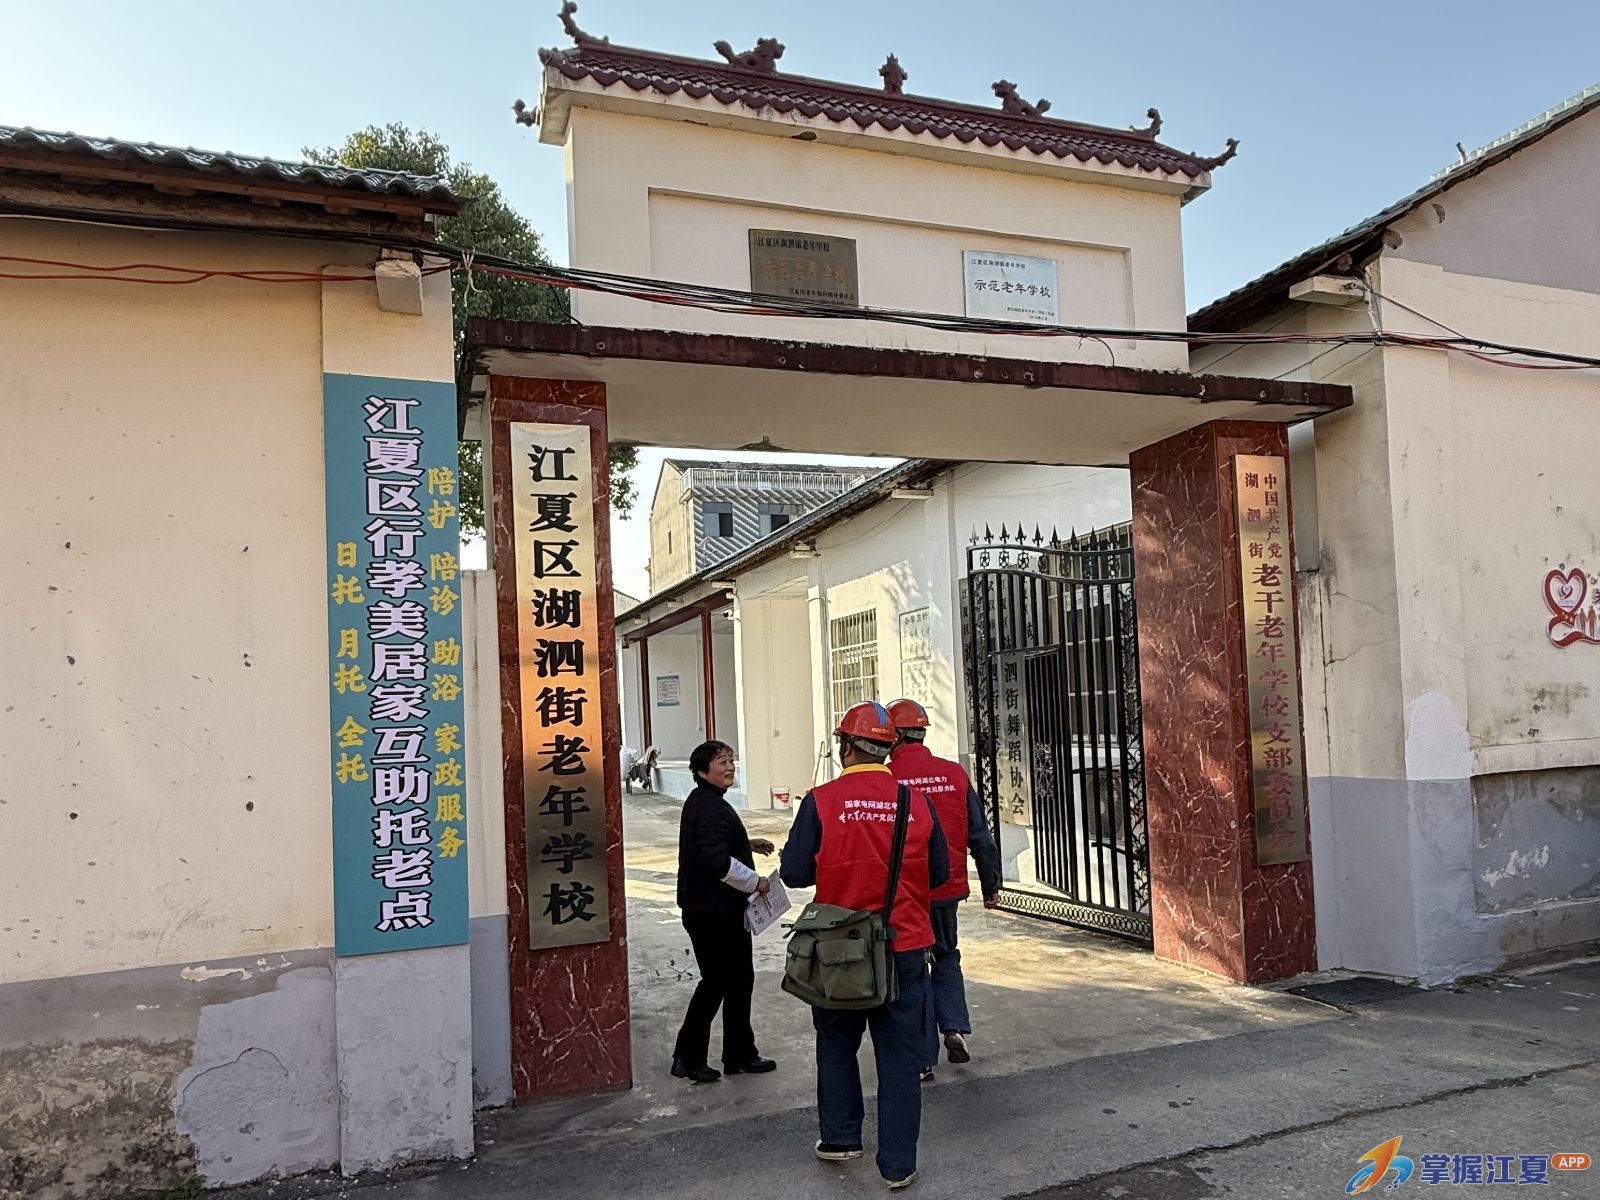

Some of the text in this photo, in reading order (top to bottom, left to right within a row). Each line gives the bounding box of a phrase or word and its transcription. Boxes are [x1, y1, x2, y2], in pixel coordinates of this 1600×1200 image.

[974, 279, 1051, 298] 示范老年学校
[1264, 473, 1283, 560] 中国共产党
[331, 541, 369, 784] 日托 月托 全托
[361, 394, 435, 931] 江夏区行孝美居家互助托老点
[427, 466, 466, 858] 陪护 陪诊 助浴 家政服务
[527, 444, 597, 925] 江夏区湖泗街老年学校
[1251, 562, 1297, 849] 老干老年学校支部委员会
[844, 800, 898, 811] 国家电网湖北电
